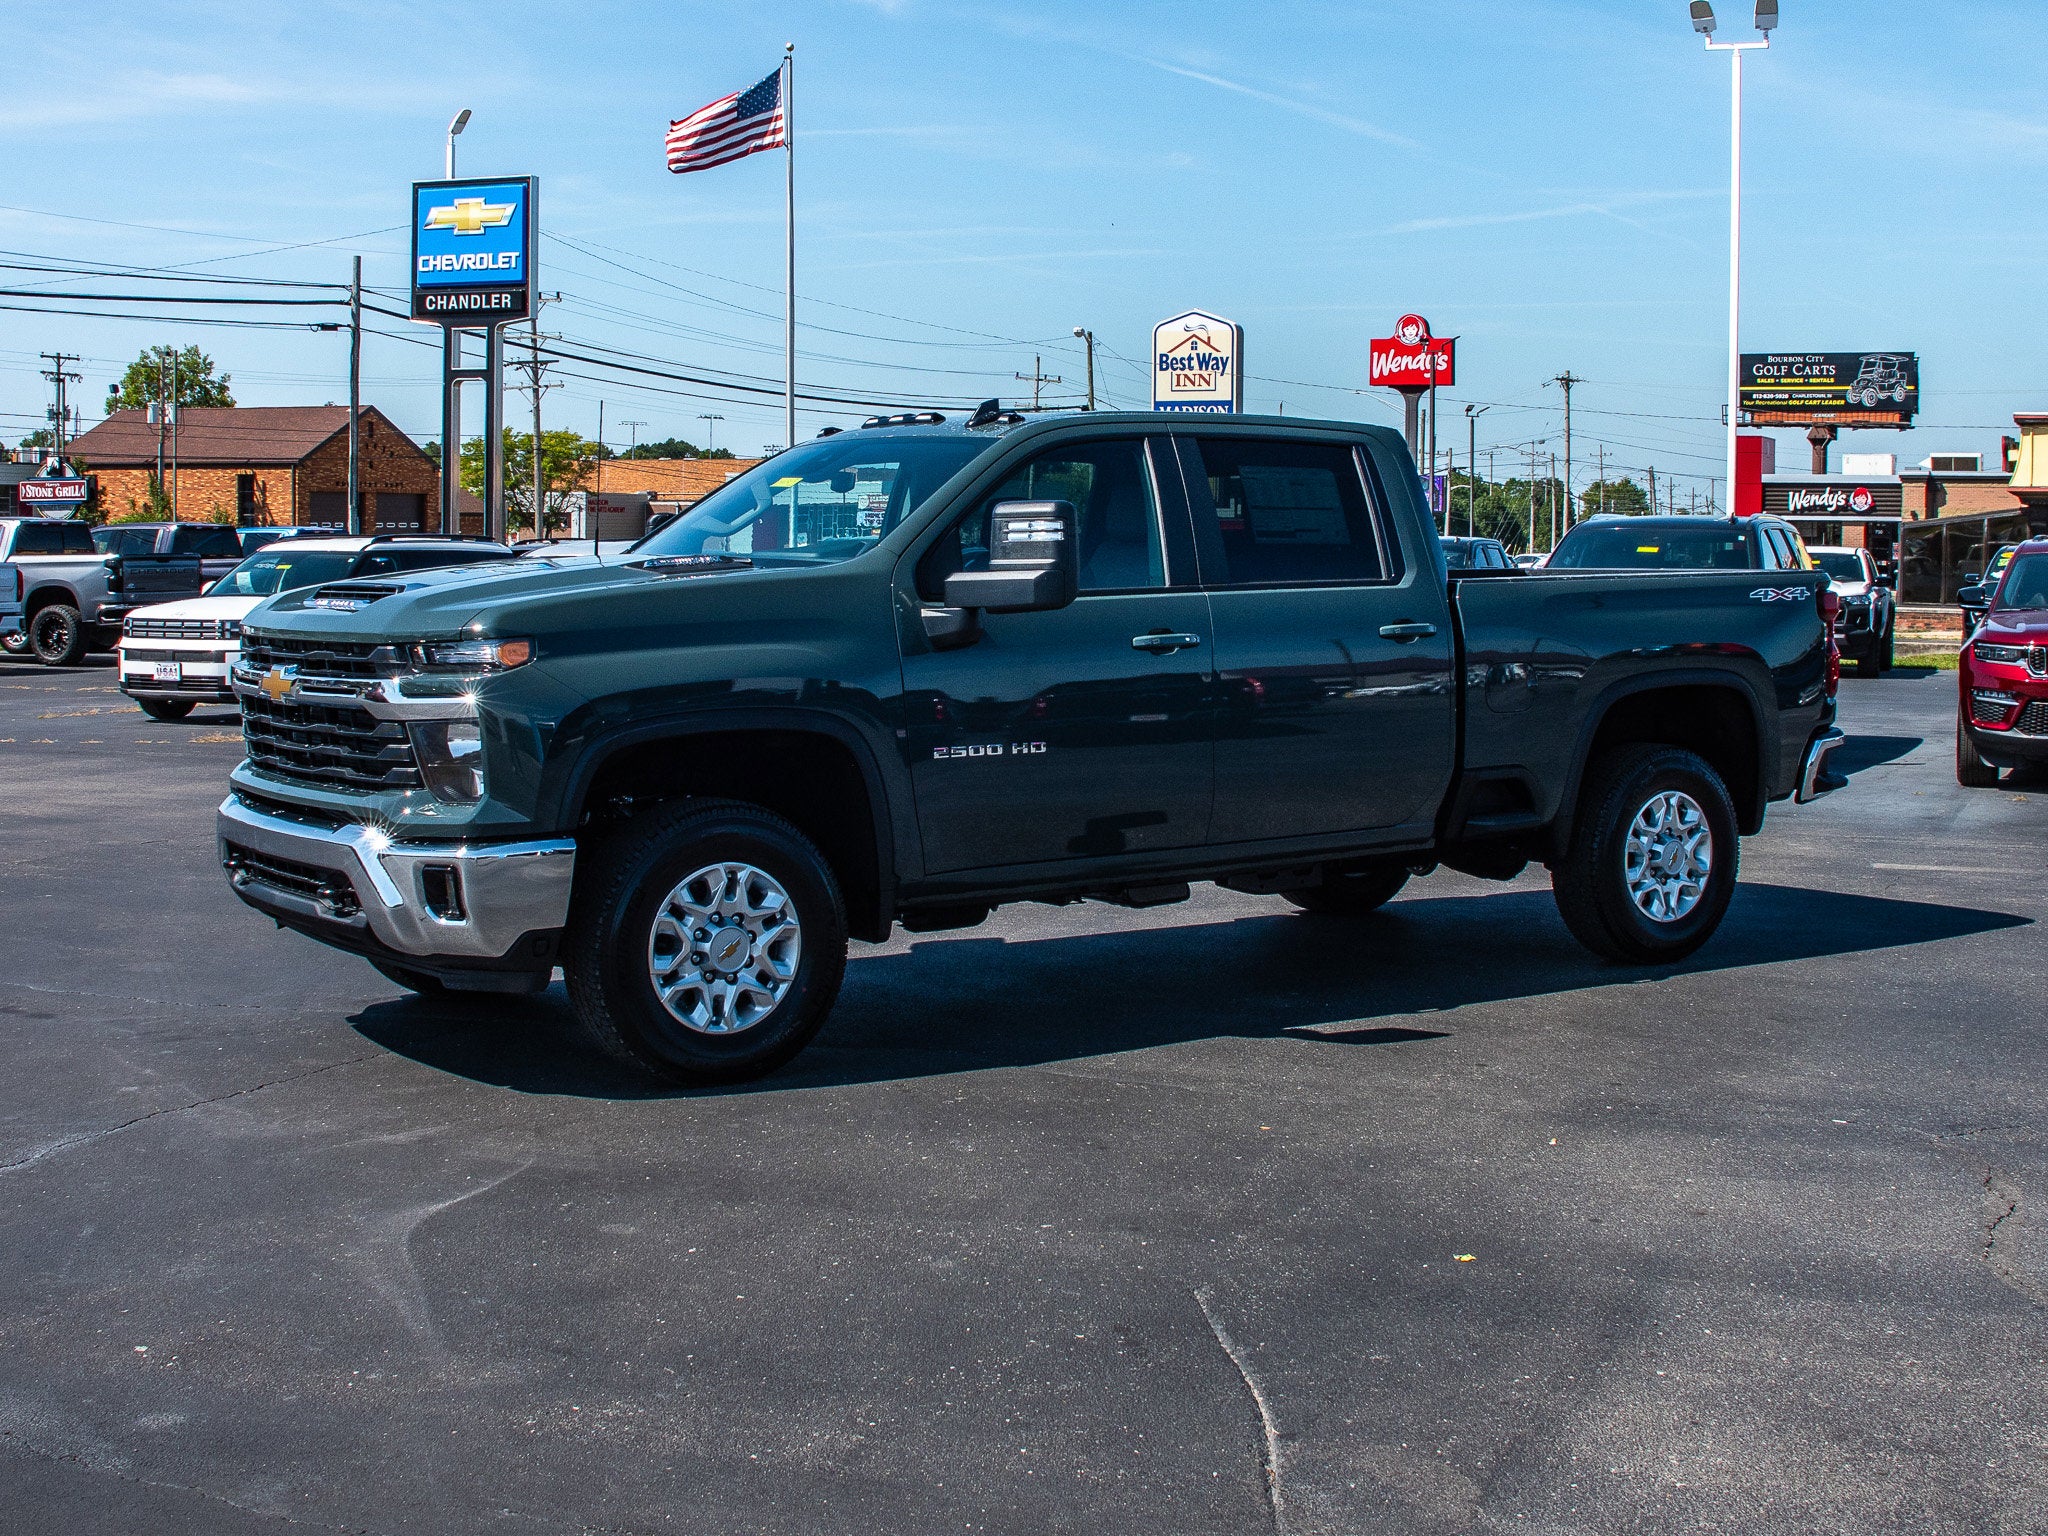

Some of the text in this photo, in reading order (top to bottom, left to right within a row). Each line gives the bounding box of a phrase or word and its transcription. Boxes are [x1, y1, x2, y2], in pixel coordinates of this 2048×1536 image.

[418, 251, 520, 272] CHEVROLET
[425, 293, 512, 310] CHANDLER
[1159, 353, 1229, 376] Best Way
[1372, 348, 1449, 379] Wendy's
[1175, 374, 1212, 387] INN
[25, 484, 81, 498] STONE GRILL
[1788, 487, 1847, 511] Wendy's
[933, 742, 1047, 759] 2500 HD
